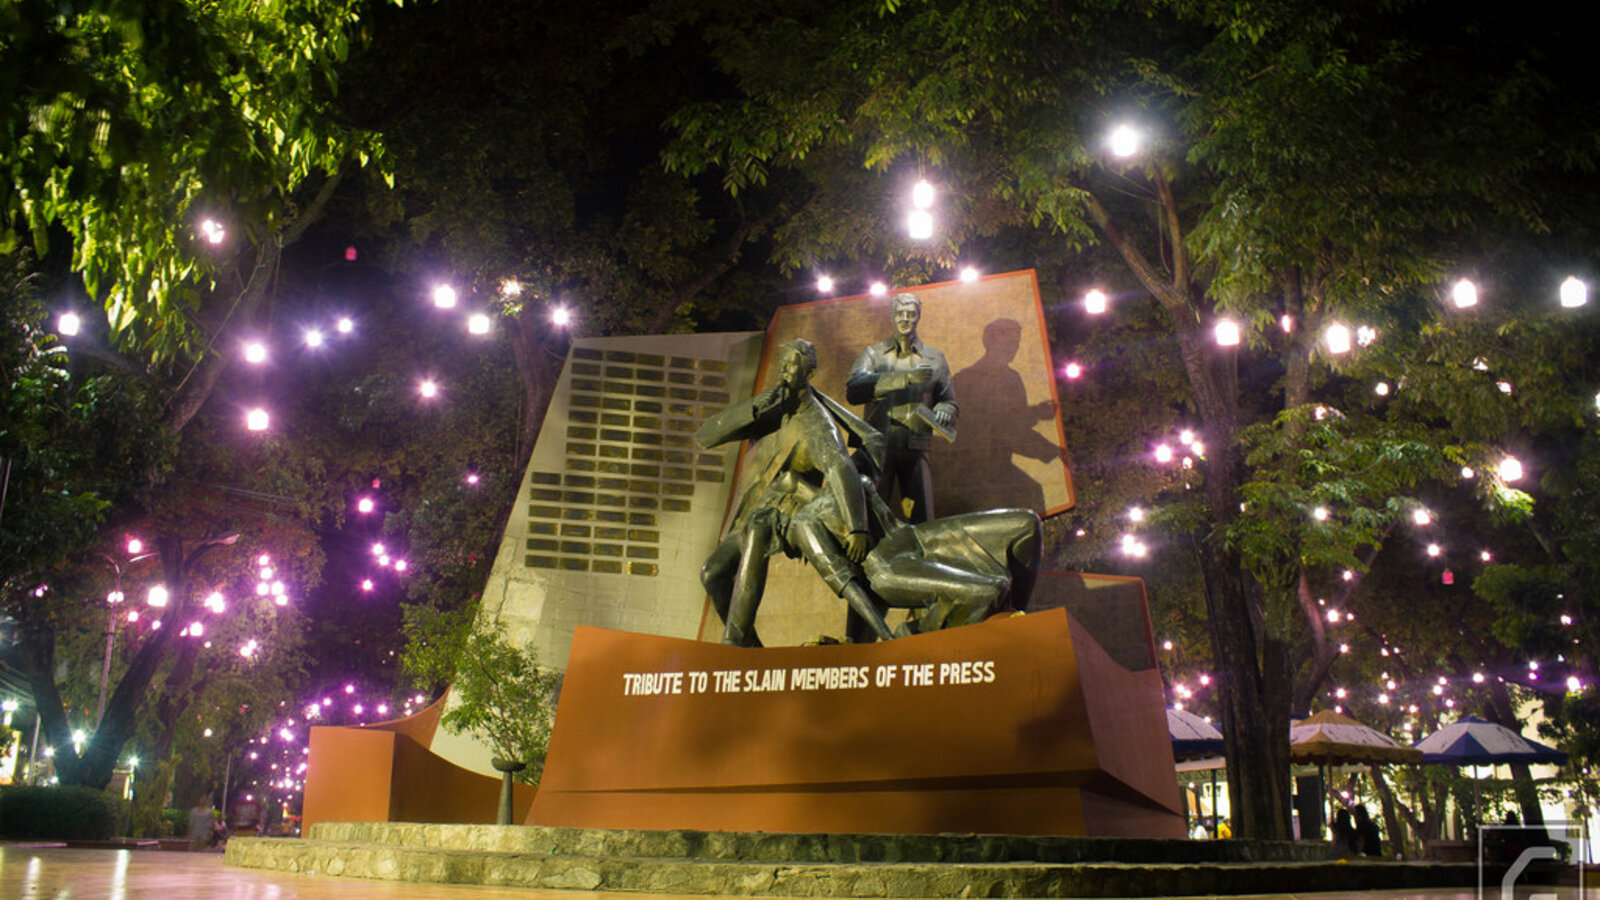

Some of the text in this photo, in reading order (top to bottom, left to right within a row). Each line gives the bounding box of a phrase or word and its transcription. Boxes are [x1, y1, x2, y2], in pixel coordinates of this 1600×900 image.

[622, 660, 996, 696] TRIBUTE TO THE SLAIN MEMBERS OF THE PRESS
